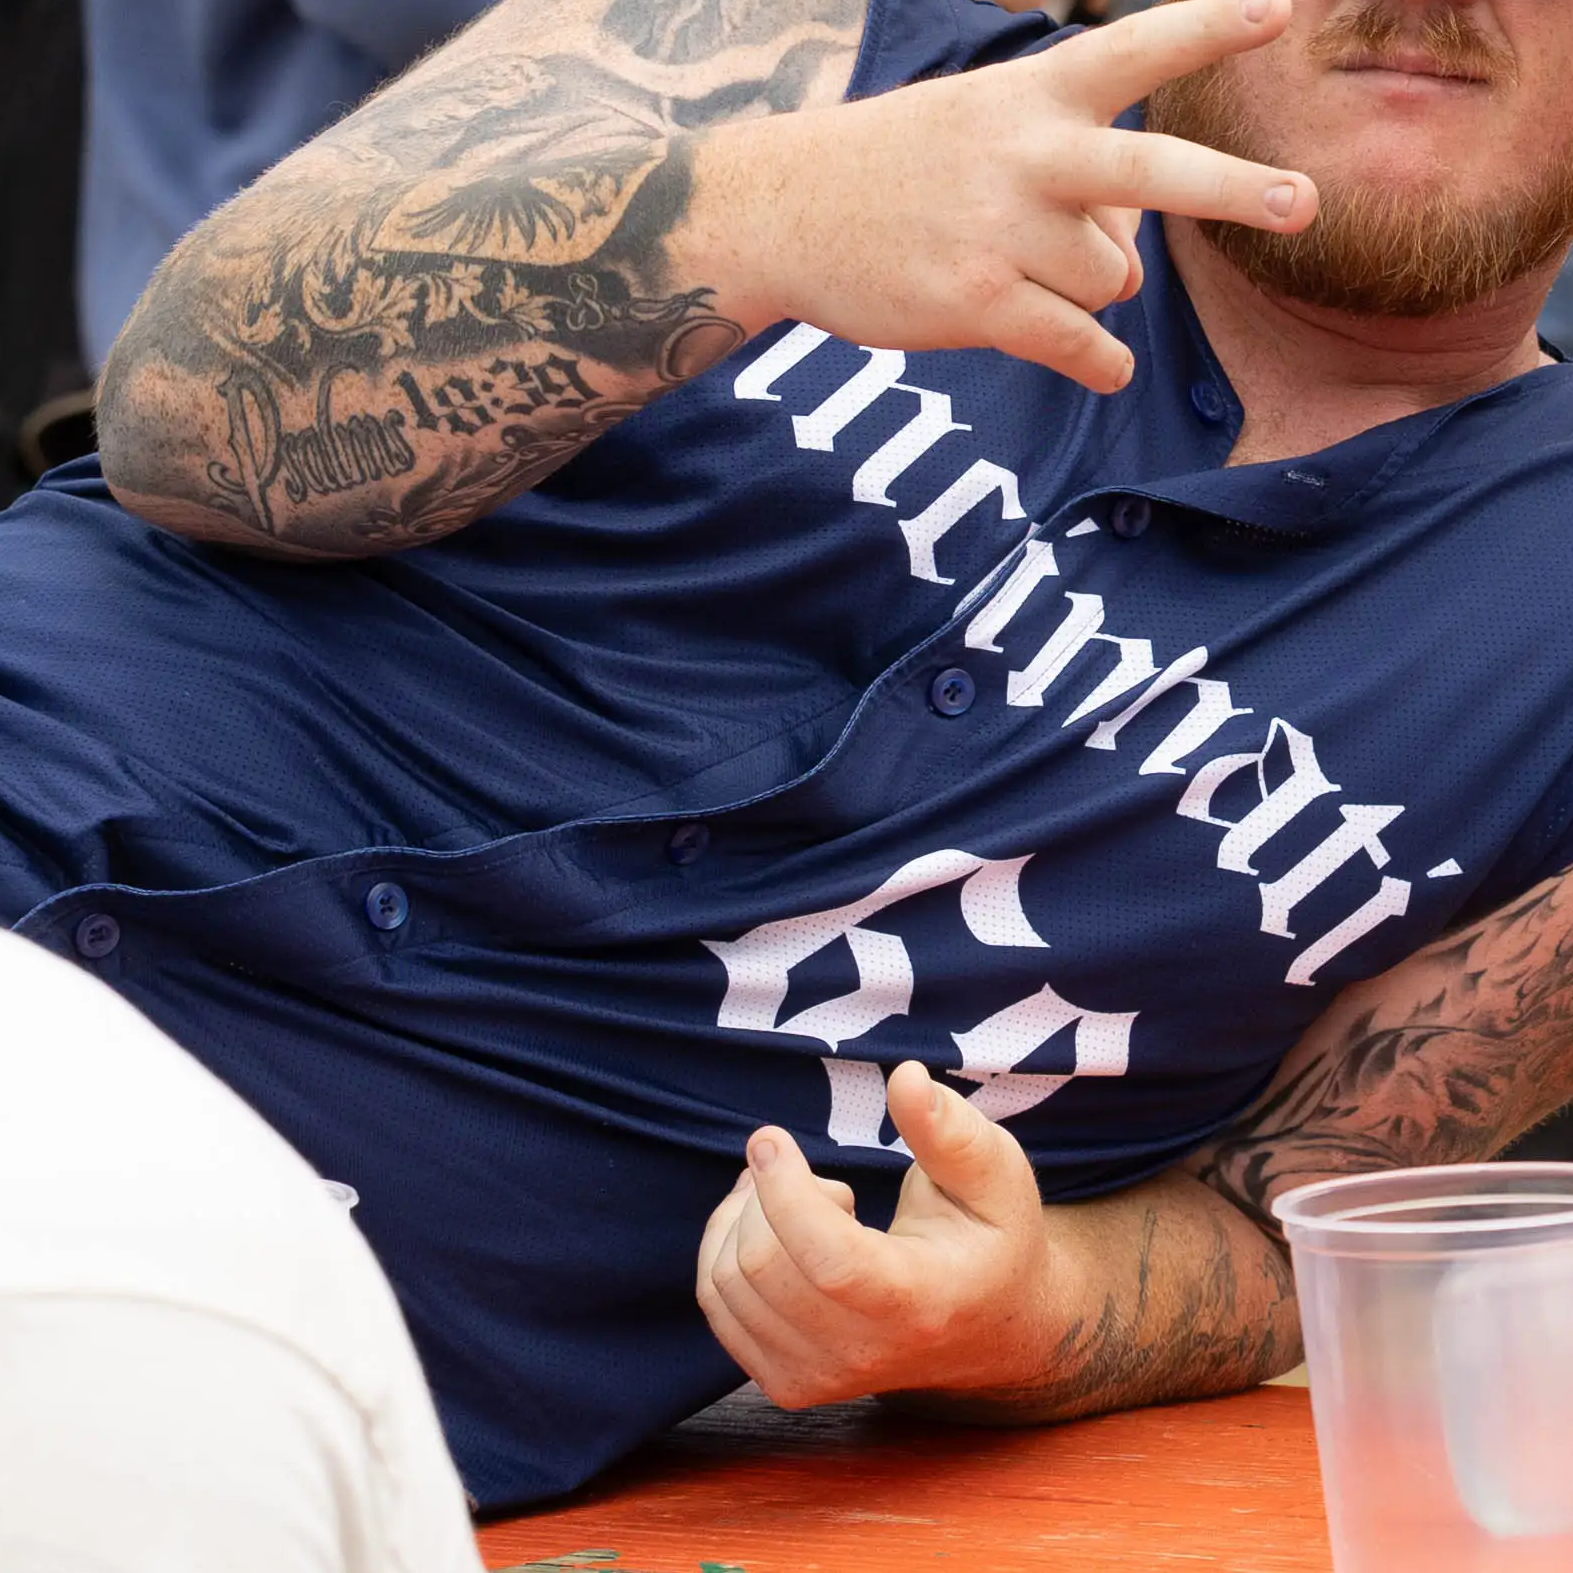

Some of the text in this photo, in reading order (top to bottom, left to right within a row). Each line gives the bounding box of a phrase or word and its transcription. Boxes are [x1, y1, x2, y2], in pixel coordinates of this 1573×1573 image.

[206, 352, 604, 538] Psalms 18:39
[733, 320, 1464, 988] incinnati
